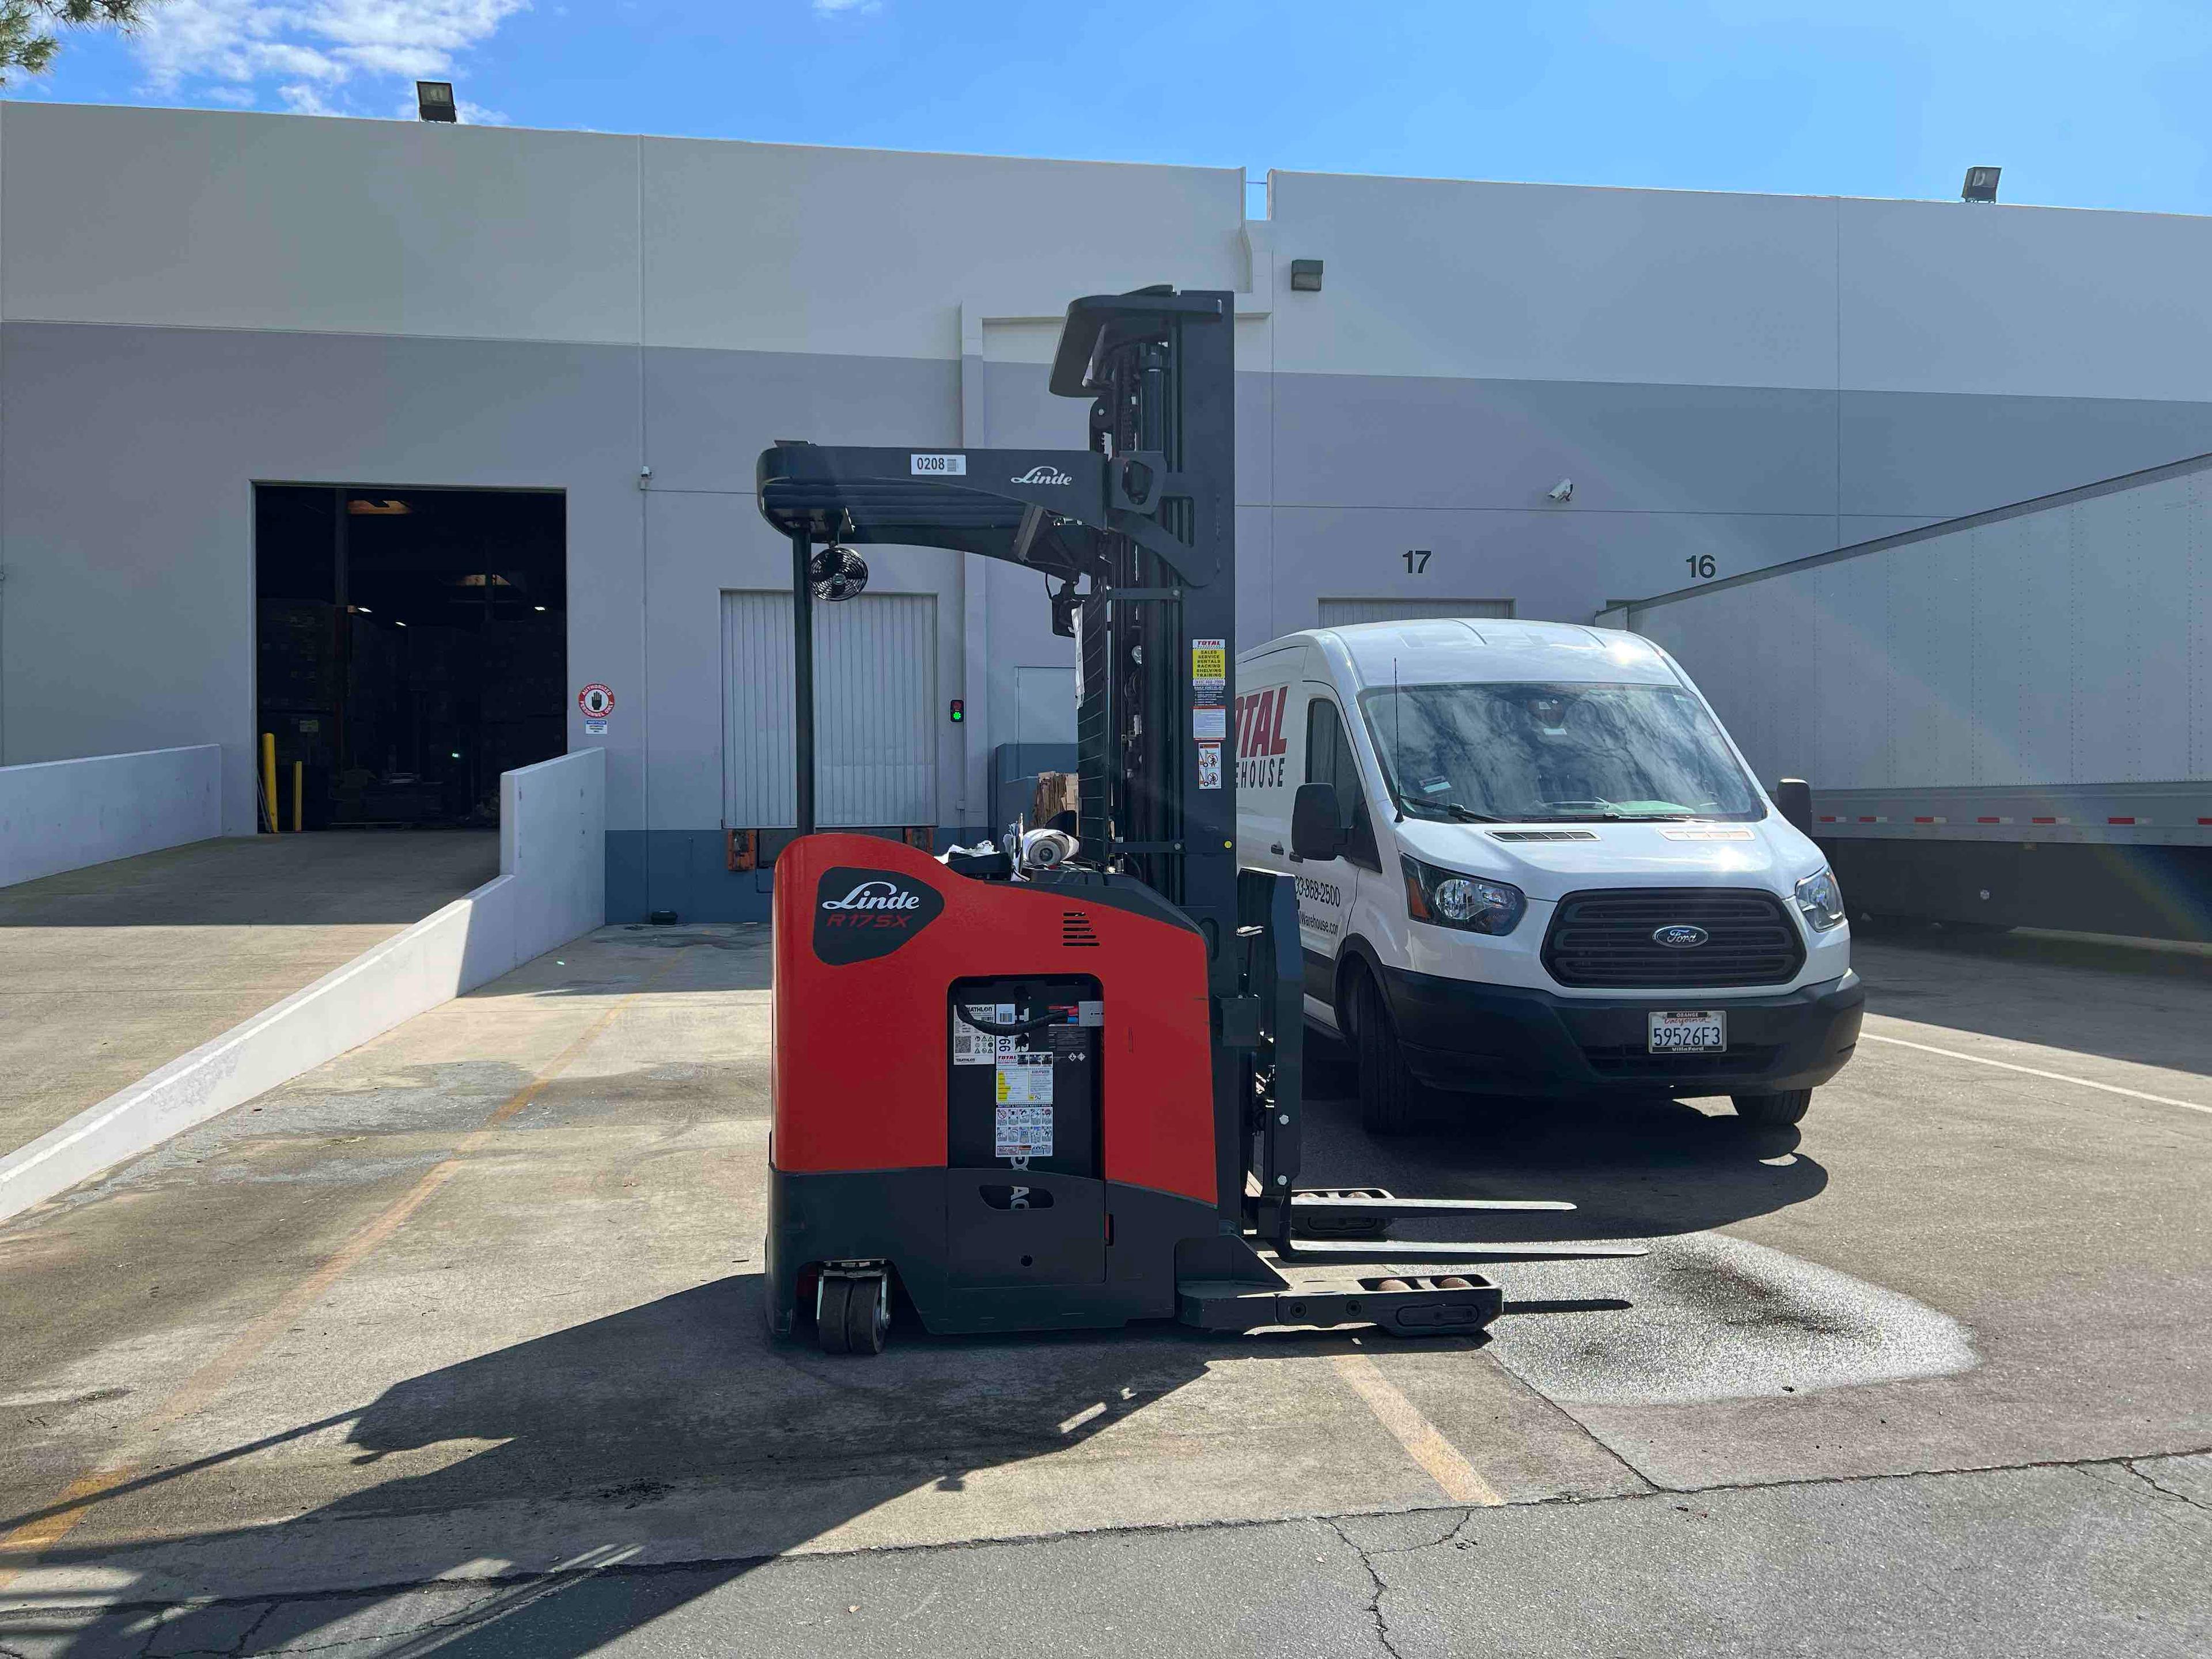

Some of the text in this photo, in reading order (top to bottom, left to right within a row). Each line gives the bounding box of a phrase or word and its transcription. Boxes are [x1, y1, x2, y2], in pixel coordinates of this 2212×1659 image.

[917, 457, 945, 470] 0208
[1010, 466, 1072, 485] Linde
[1402, 550, 1432, 574] 17
[1685, 555, 1717, 579] 16
[822, 881, 920, 910] Linde
[1666, 929, 1698, 943] Ford
[1653, 1027, 1721, 1046] 59526F3
